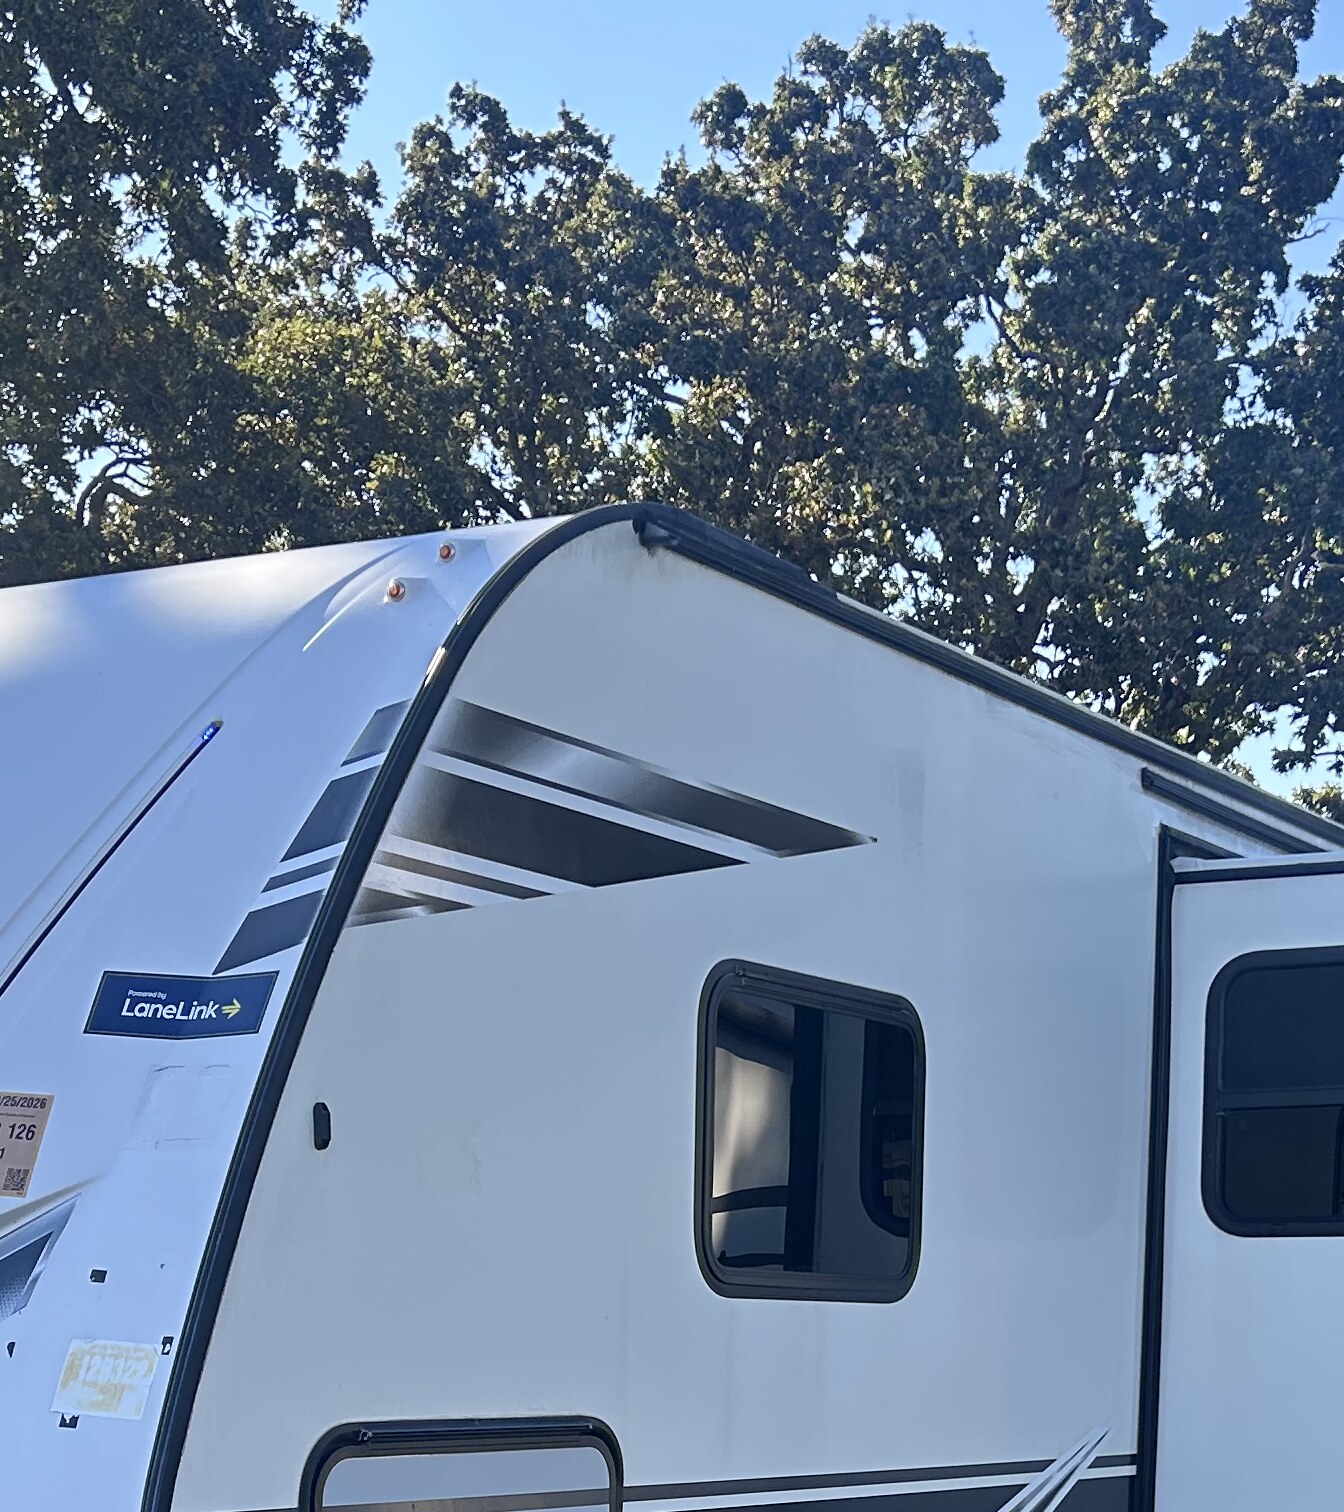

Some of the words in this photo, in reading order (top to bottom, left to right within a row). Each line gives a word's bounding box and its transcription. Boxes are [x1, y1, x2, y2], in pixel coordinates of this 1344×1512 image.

[120, 997, 220, 1020] LaneLink
[8, 1122, 37, 1140] 126
[0, 1147, 5, 1160] 1
